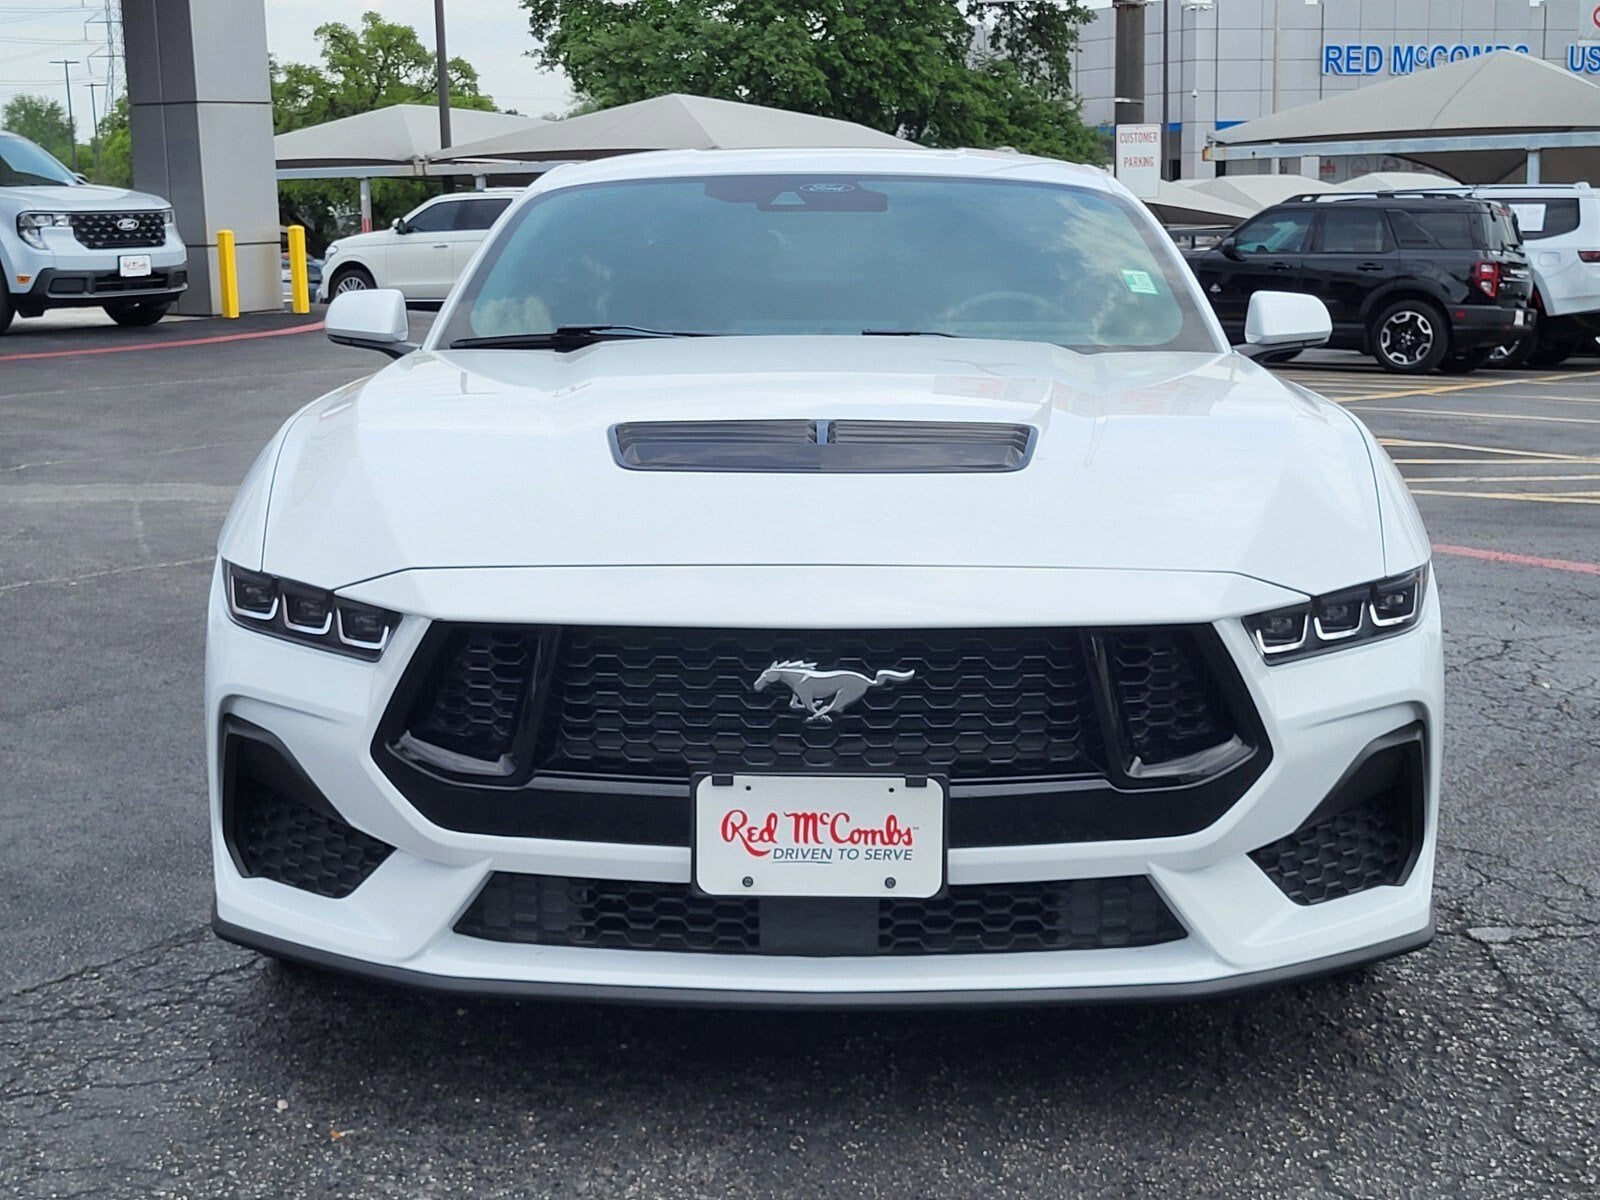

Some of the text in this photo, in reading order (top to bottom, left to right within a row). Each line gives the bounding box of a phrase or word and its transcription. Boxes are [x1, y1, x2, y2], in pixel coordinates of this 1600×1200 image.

[1324, 45, 1529, 73] RED McCO
[1120, 132, 1158, 143] CUSTOMER
[1123, 156, 1154, 168] PARKING
[721, 810, 913, 857] Red McCombs
[773, 848, 913, 861] DRIVEN TO SERVE
